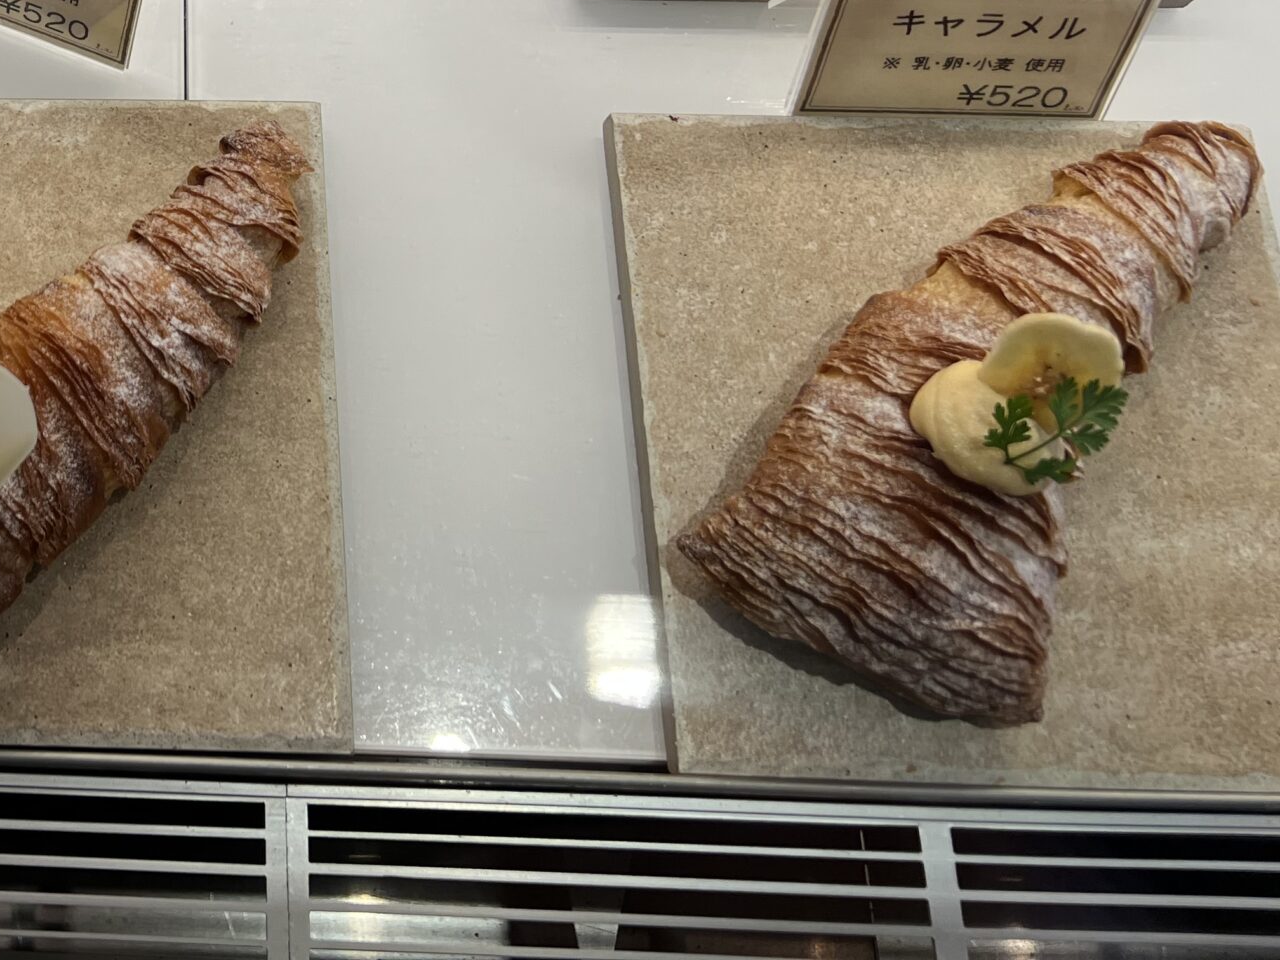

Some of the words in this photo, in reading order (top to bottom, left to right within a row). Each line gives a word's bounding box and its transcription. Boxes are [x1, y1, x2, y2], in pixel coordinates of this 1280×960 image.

[892, 9, 1087, 40] キャラメル
[1024, 57, 1066, 74] 使用
[956, 83, 1068, 109] ¥520
